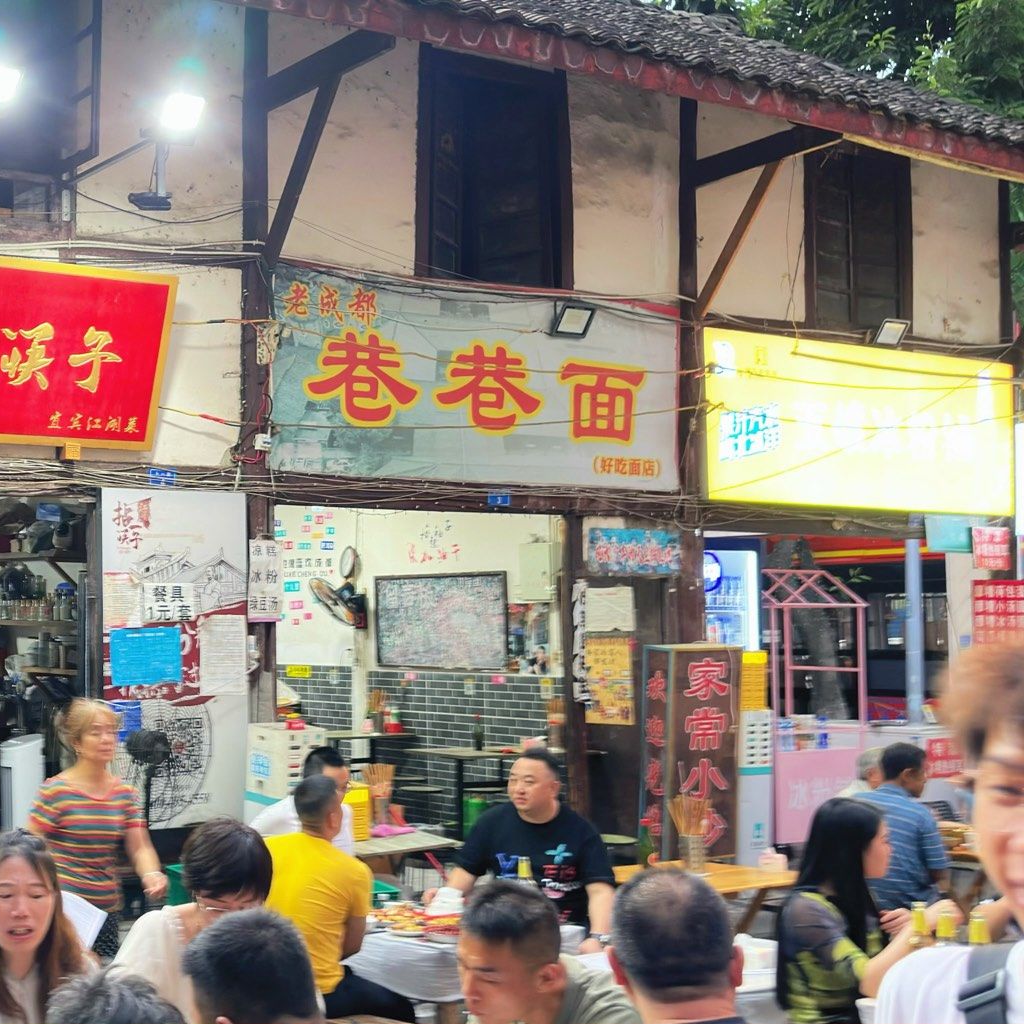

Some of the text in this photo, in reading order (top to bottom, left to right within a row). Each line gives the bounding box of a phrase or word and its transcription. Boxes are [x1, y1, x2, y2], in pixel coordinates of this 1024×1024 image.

[283, 282, 378, 326] 老成都
[305, 330, 647, 444] 巷巷面
[592, 456, 661, 476] (好吃面店)
[152, 585, 184, 603] 餐具
[147, 605, 192, 621] 1元/套
